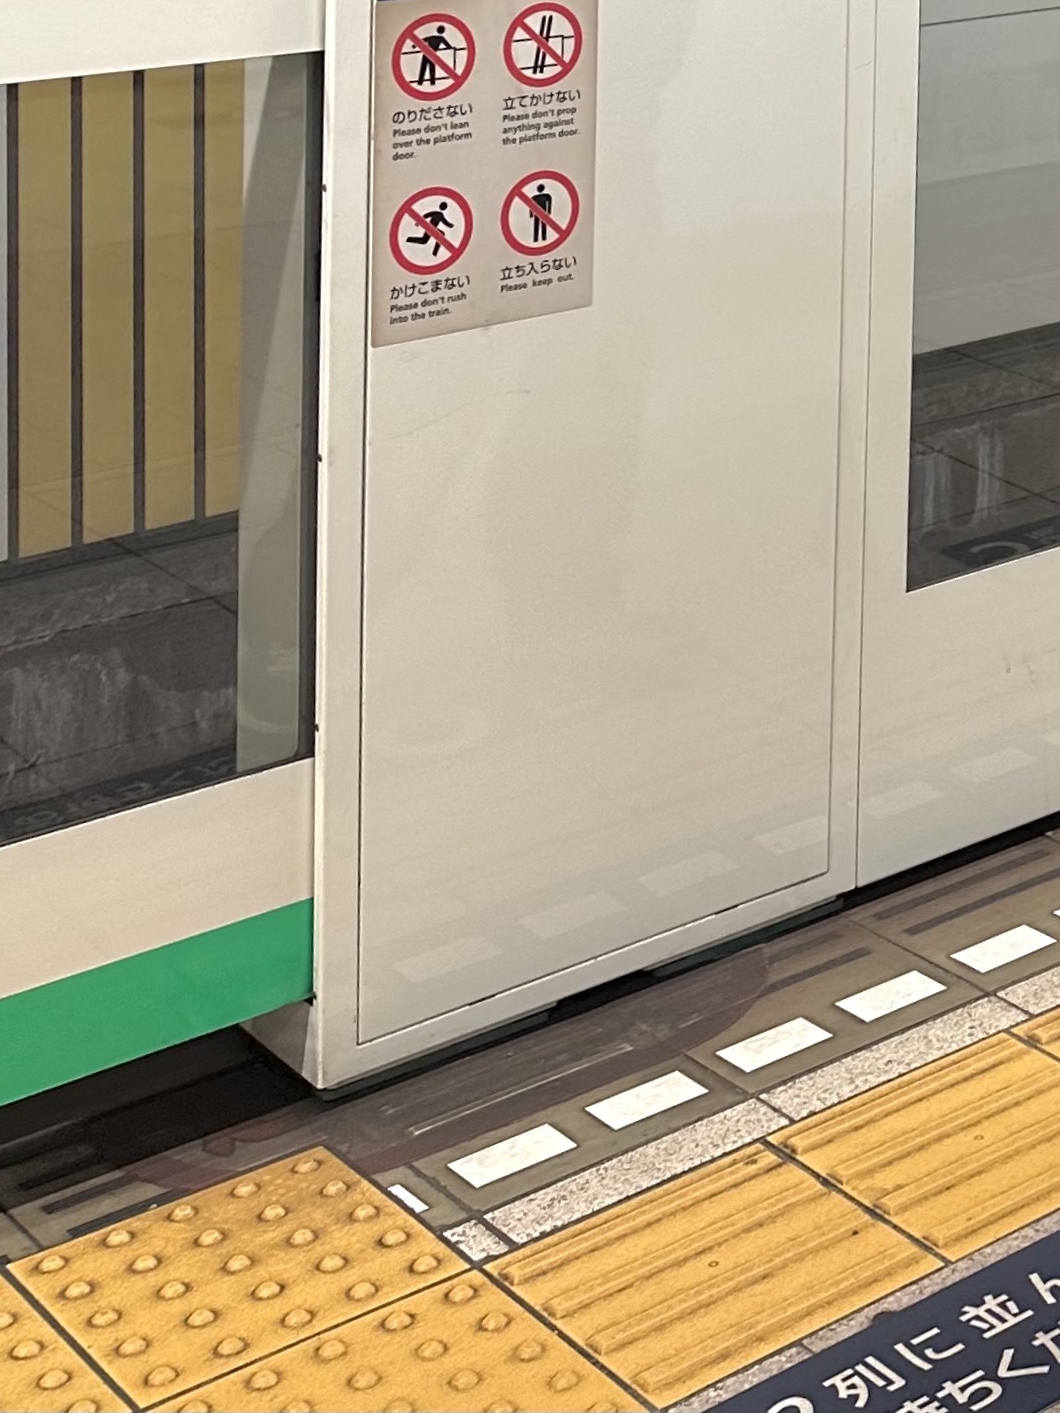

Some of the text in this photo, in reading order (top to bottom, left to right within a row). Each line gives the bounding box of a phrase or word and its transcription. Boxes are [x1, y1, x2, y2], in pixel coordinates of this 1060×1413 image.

[502, 89, 581, 110] 立てかけない
[392, 103, 473, 124] のりださない
[502, 107, 577, 122] Please don't prop
[393, 121, 469, 137] Please don't lean
[502, 118, 574, 134] anything against
[392, 132, 472, 149] over the platform
[502, 128, 580, 145] the platform door.
[392, 152, 417, 161] door.
[500, 256, 577, 280] 立ち入らない
[390, 275, 471, 300] かけこまない
[500, 282, 528, 293] Please
[533, 277, 553, 287] keep
[390, 292, 467, 313] Please don't rush
[390, 307, 452, 325] into the train.
